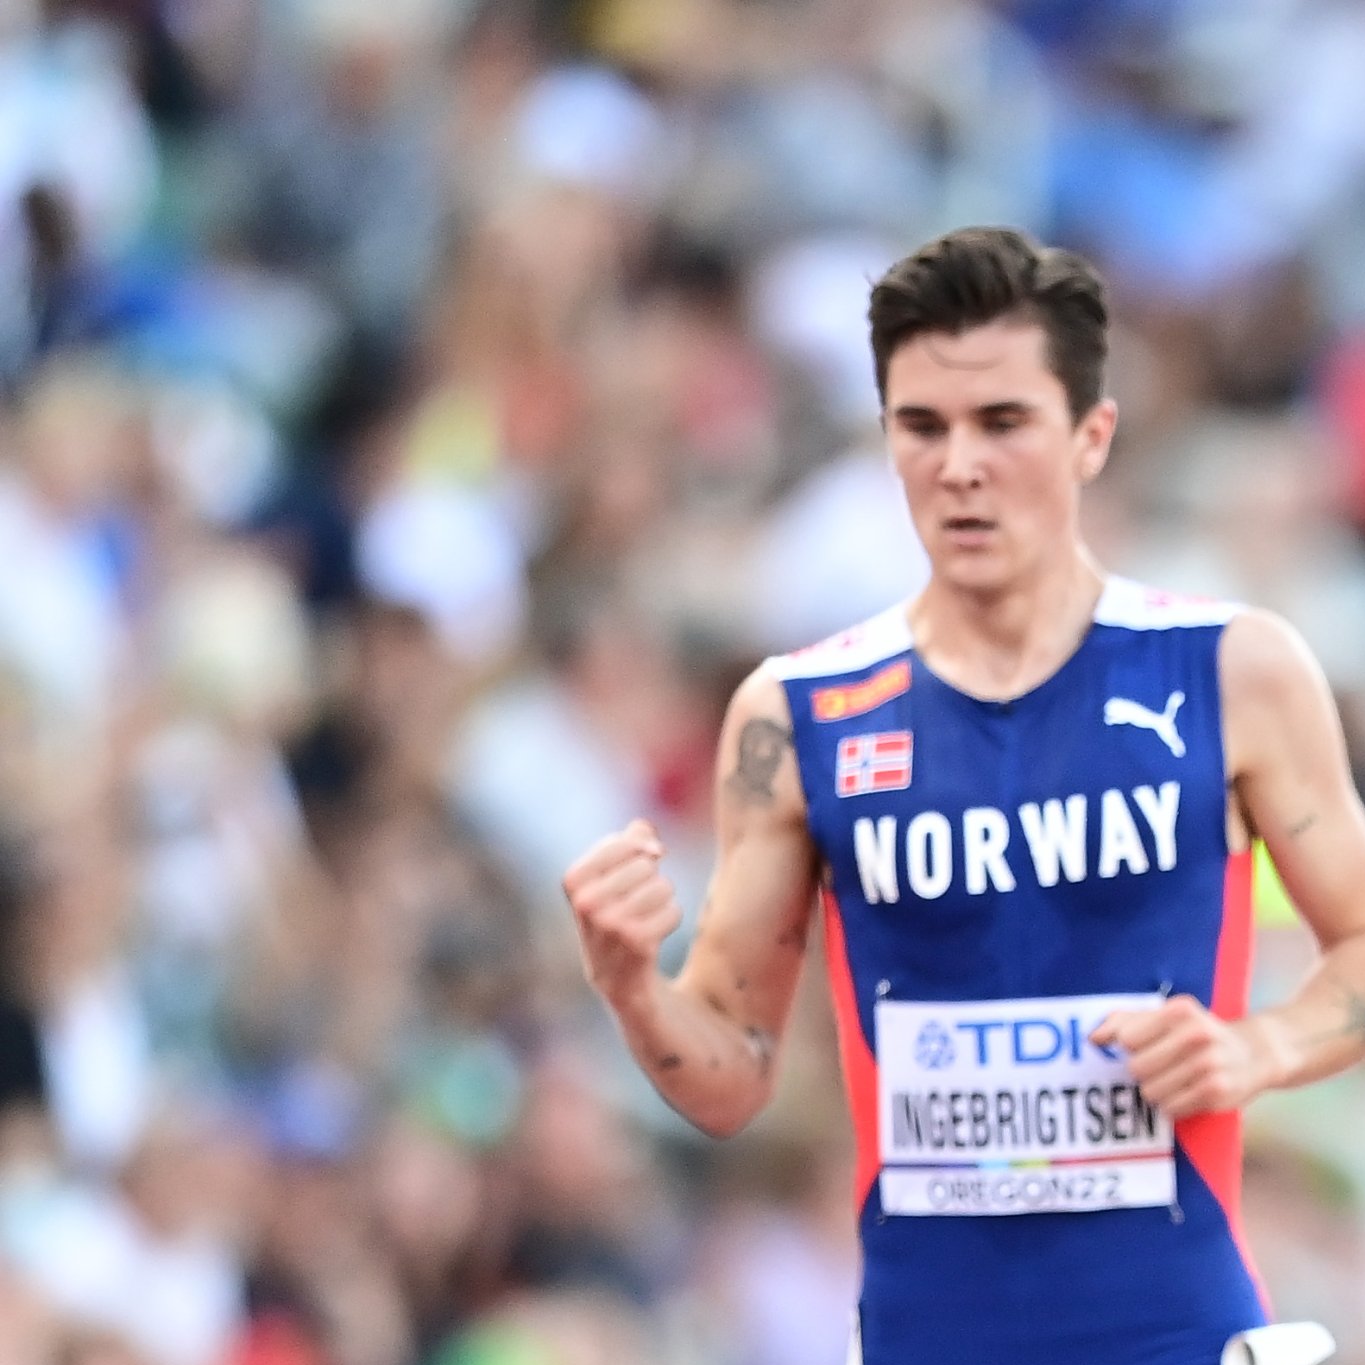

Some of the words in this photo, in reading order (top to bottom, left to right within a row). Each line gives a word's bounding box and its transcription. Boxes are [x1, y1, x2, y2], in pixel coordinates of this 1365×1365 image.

[853, 781, 1182, 905] NORWAY
[892, 1079, 1158, 1149] INGEBRIGTSEN
[927, 1170, 1123, 1208] OREGON22
